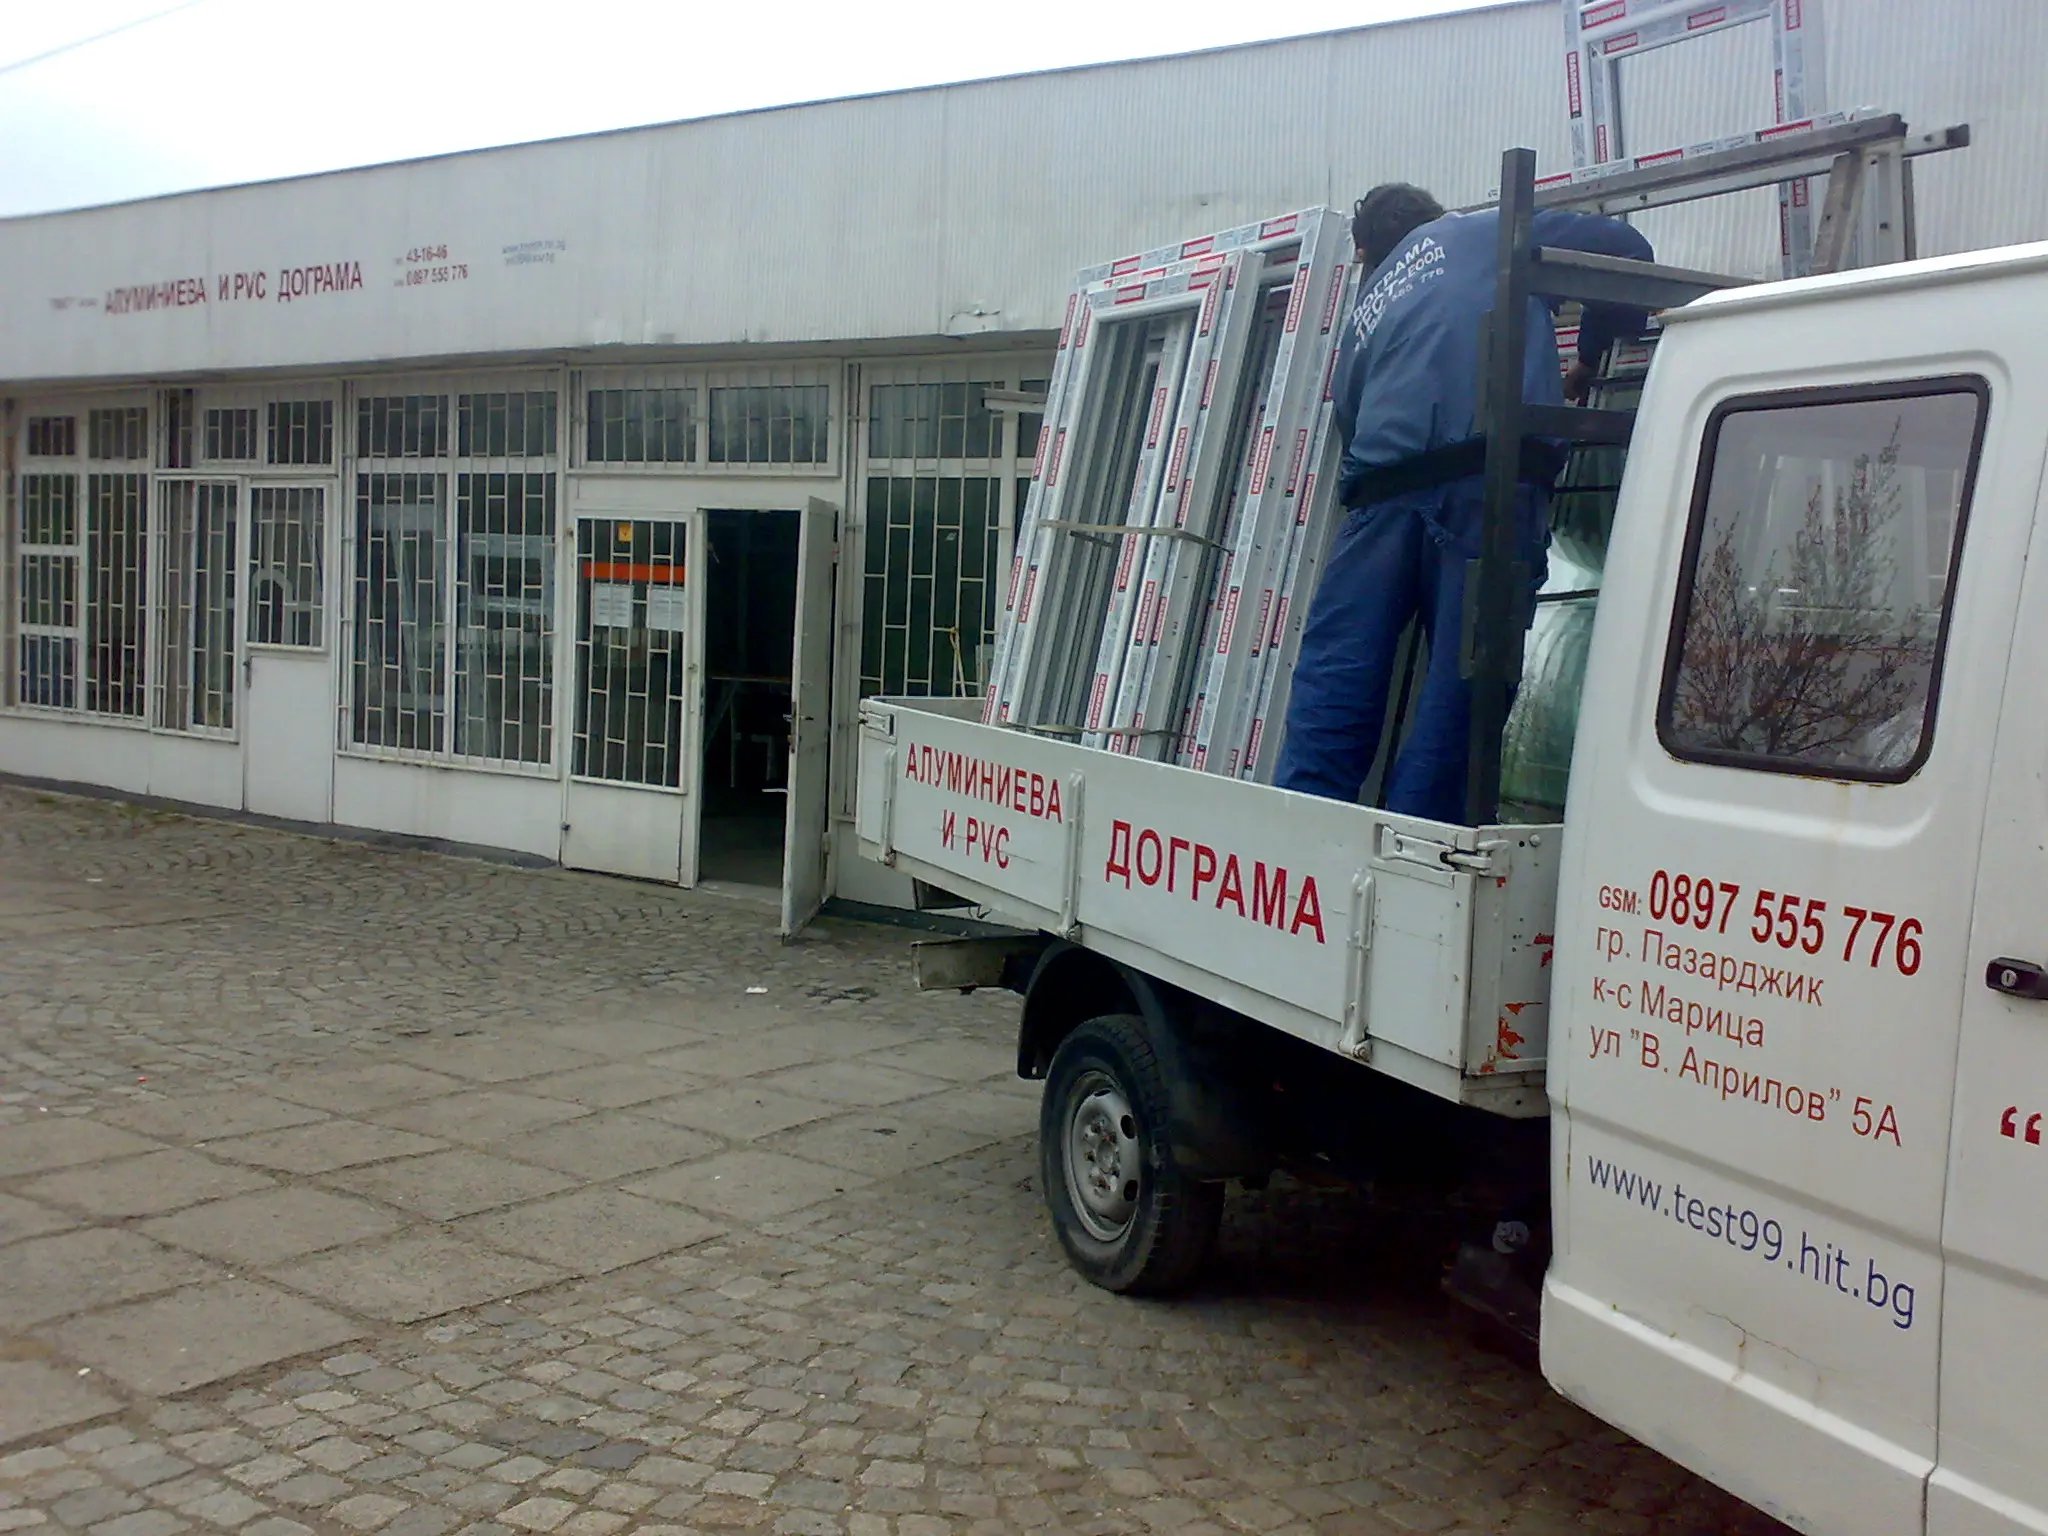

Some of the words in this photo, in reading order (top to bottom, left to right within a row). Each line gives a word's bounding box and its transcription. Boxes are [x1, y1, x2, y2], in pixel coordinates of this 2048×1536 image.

[105, 278, 206, 314] АЛУМИНИЕВА
[219, 274, 229, 300] И
[235, 271, 266, 299] PVC
[278, 261, 363, 302] ДОГРАМА
[905, 742, 1062, 824] АЛУМИНИЕВА
[942, 809, 956, 851] И
[966, 816, 1012, 871] PVC
[1105, 819, 1327, 945] ДОГРАМА
[1598, 885, 1643, 916] GSM:
[1649, 870, 1740, 934] 0897
[1751, 890, 1827, 955] 555
[1843, 906, 1925, 976] 776
[1596, 926, 1631, 962] гр.
[1641, 929, 1824, 1007] Пазарджик
[1589, 1024, 1621, 1060] ул
[1593, 977, 1632, 1009] к-с
[1640, 980, 1765, 1047] Марица
[1588, 1156, 1915, 1330] www.test99.hit.bg
